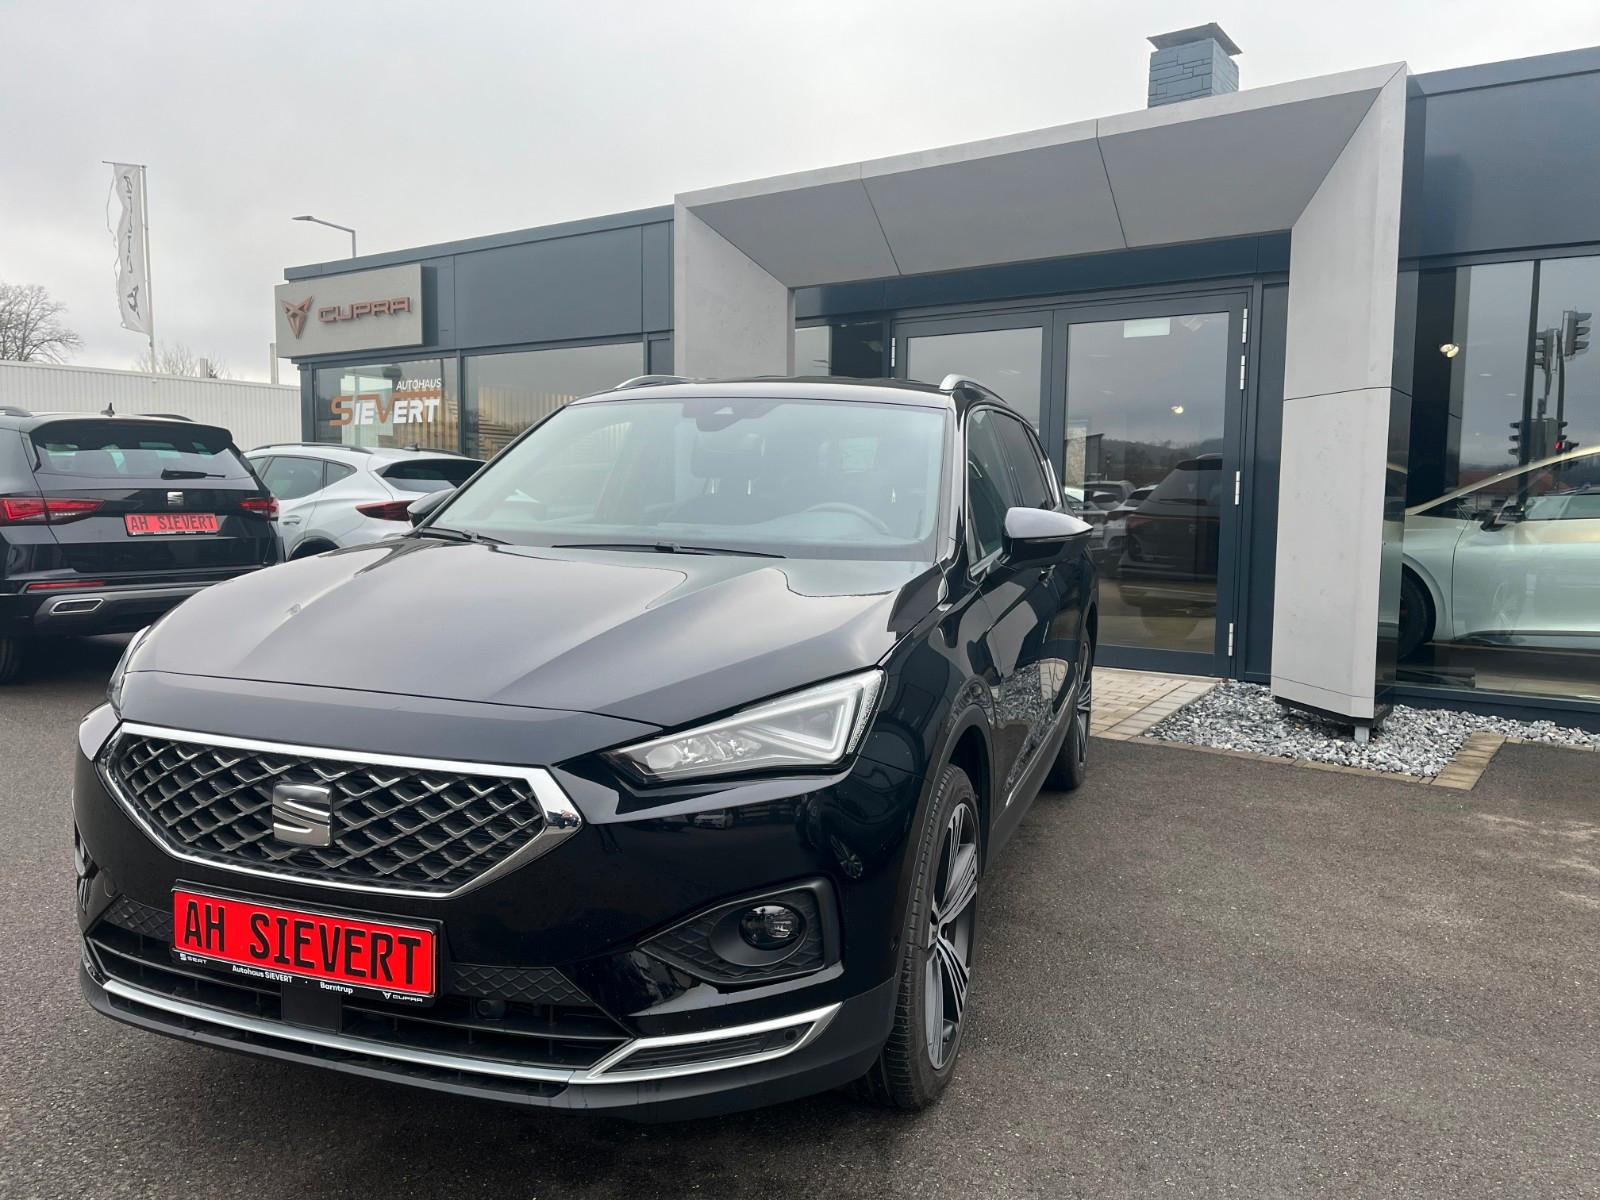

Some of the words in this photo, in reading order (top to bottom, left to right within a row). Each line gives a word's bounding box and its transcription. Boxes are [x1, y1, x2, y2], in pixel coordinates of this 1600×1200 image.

[317, 296, 411, 323] CUPRA
[396, 377, 442, 391] AUTOHAUS
[329, 390, 442, 427] SIEVERT
[131, 516, 150, 531] AH
[158, 513, 214, 530] SIEVERT
[183, 900, 226, 952] AH
[250, 913, 422, 985] SIEVERT
[232, 964, 265, 978] Autohaus
[264, 970, 293, 983] SIEVERT
[319, 981, 354, 995] Barntrup
[392, 993, 423, 1003] CUPRA
